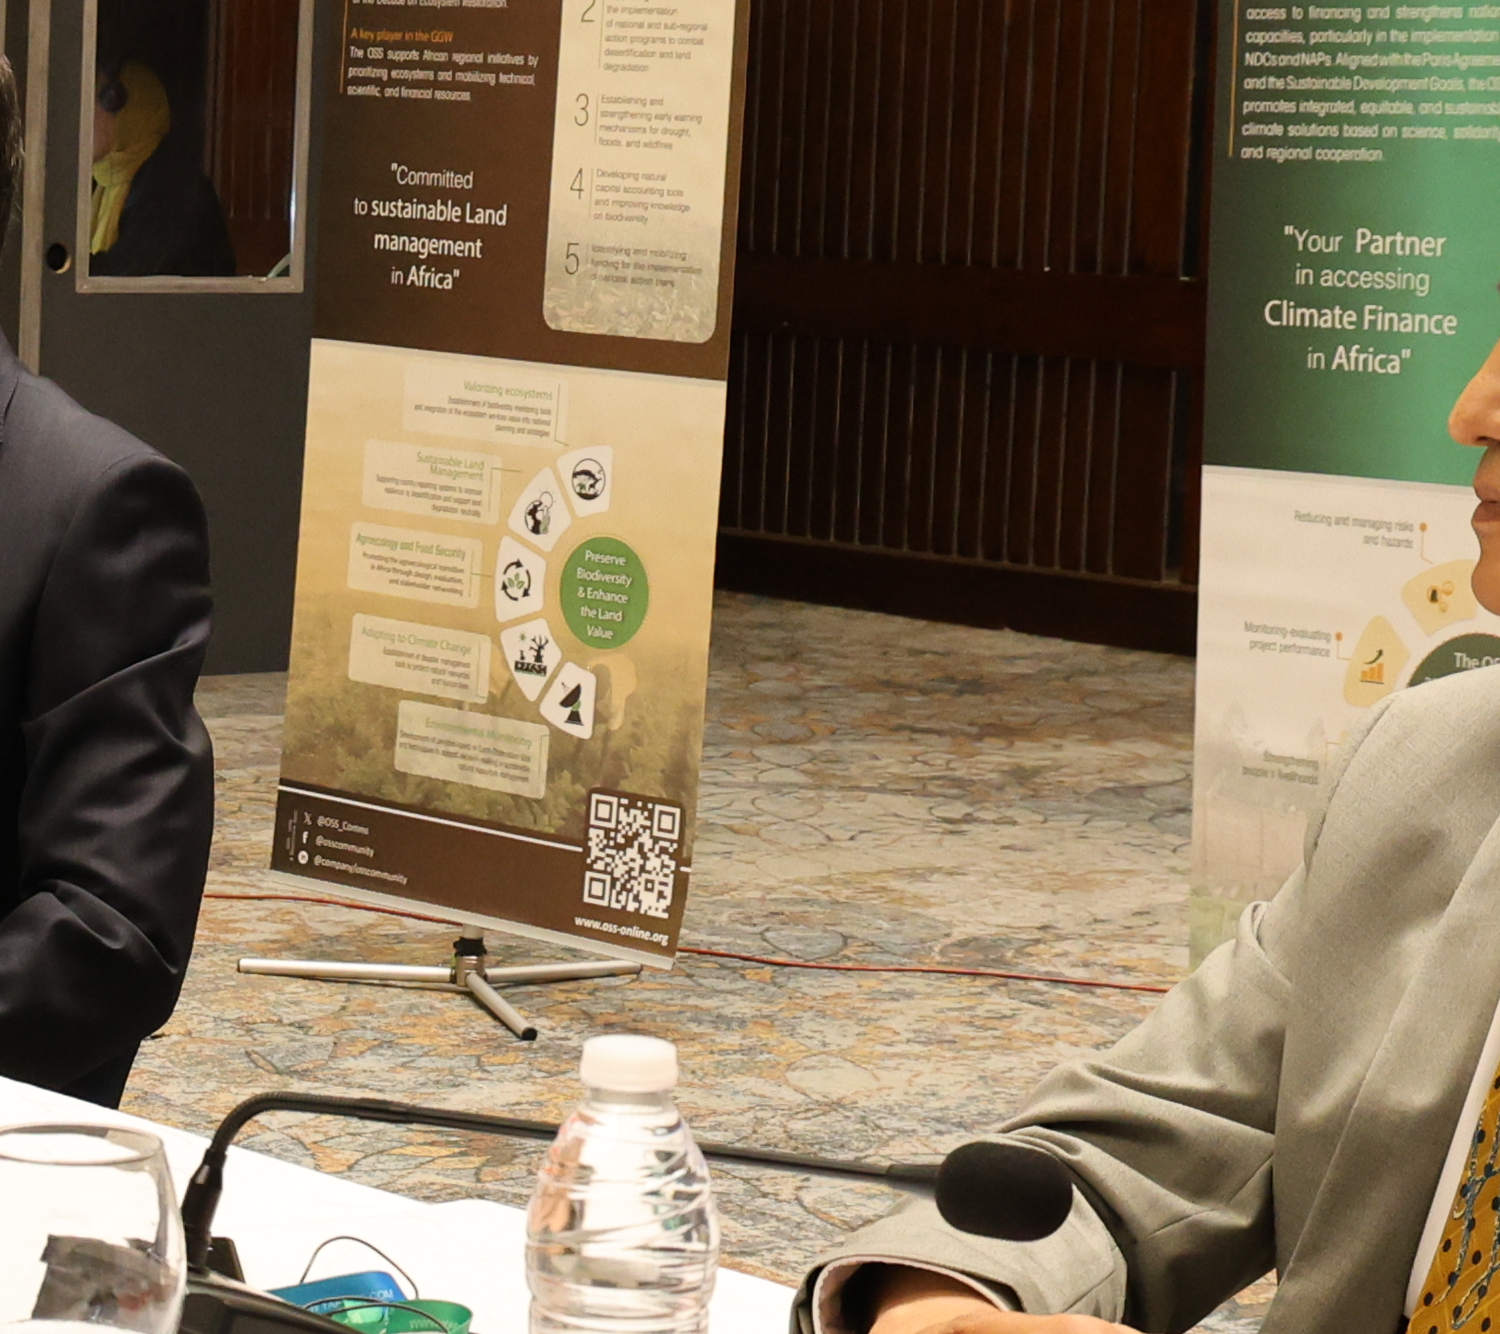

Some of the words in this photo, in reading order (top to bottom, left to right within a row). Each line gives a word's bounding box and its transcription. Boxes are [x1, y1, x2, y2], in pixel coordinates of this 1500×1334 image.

[574, 93, 589, 126] 3
[569, 168, 585, 200] 4
[354, 198, 367, 216] to
[370, 198, 461, 223] sustainable
[466, 205, 508, 226] Land
[374, 233, 482, 258] management
[1355, 228, 1447, 257] Partner
[564, 242, 579, 275] 5
[391, 268, 404, 285] in
[1295, 263, 1314, 285] in
[1320, 268, 1431, 297] accessing
[1264, 300, 1357, 329] Climate
[1362, 305, 1458, 335] Finance
[1307, 347, 1326, 369] in
[585, 550, 626, 566] Preserve
[577, 567, 632, 588] Biodiversity
[577, 586, 585, 598] &
[587, 587, 628, 603] Enhance
[580, 606, 597, 618] the
[598, 608, 622, 621] Land
[587, 625, 614, 639] Value
[1454, 652, 1480, 669] The
[574, 917, 669, 946] www.oss-online.org
